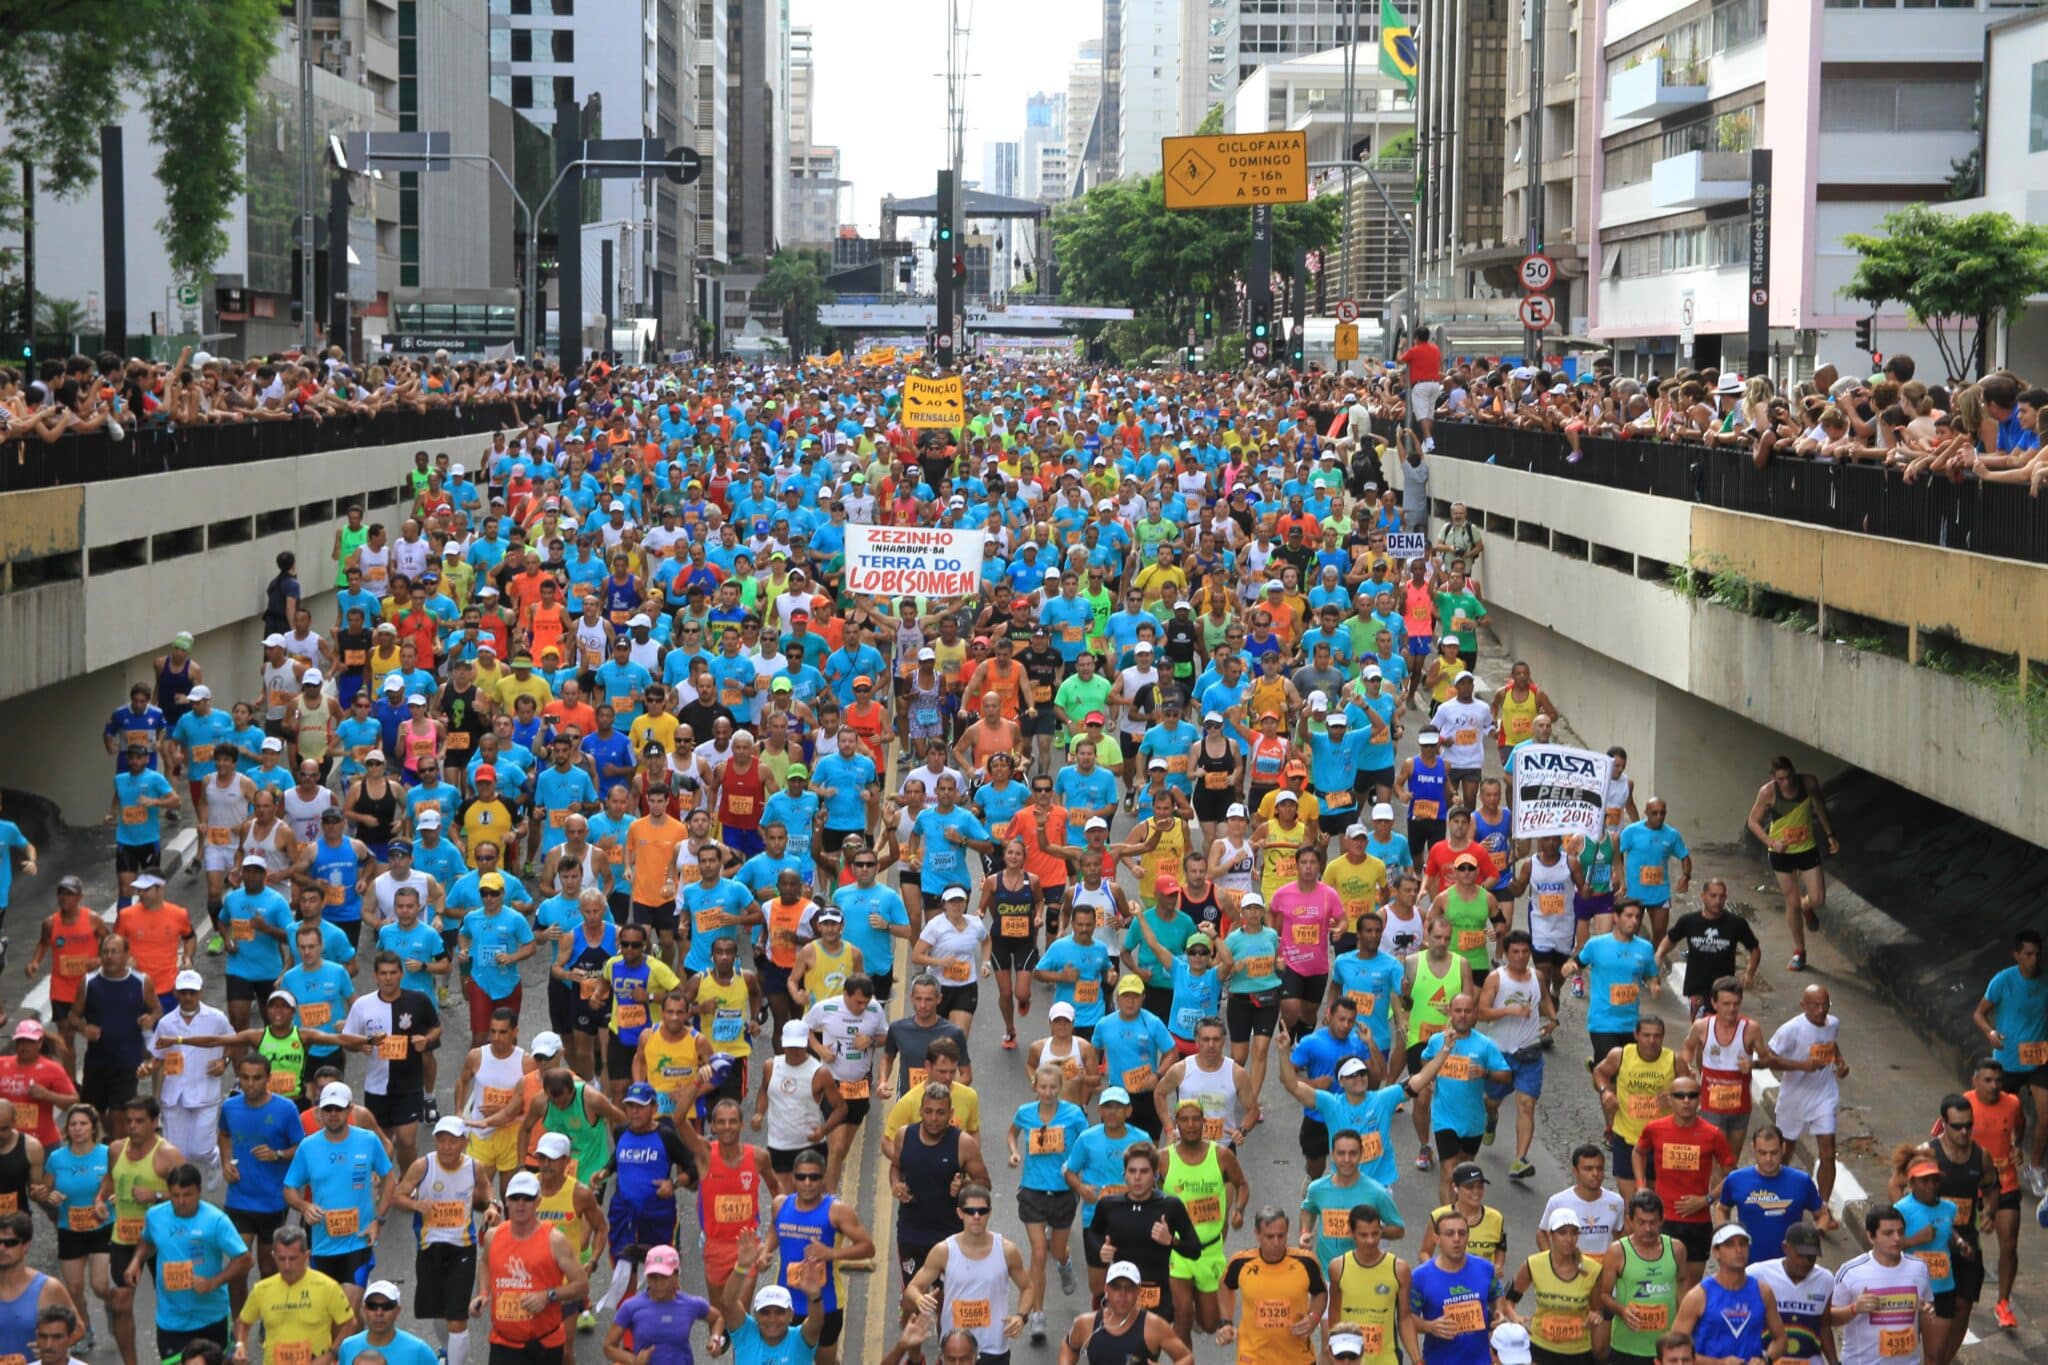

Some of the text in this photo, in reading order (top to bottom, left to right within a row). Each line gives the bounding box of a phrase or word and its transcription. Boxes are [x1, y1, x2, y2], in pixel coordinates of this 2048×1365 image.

[1218, 139, 1300, 153] CICLOFAIXA
[1229, 154, 1291, 167] DOMINGO
[1236, 186, 1287, 198] A 50 m
[1754, 184, 1764, 214] Lobo
[1753, 218, 1764, 271] Haddock
[1526, 262, 1549, 278] 50
[926, 399, 942, 407] AO
[867, 529, 954, 545] ZEZINHO
[1388, 535, 1424, 549] DENA
[858, 554, 962, 572] TERRA DO
[1524, 753, 1596, 777] NASA
[1562, 809, 1594, 825] 2015
[959, 1307, 985, 1319] 15666
[1258, 1308, 1288, 1318] 5328
